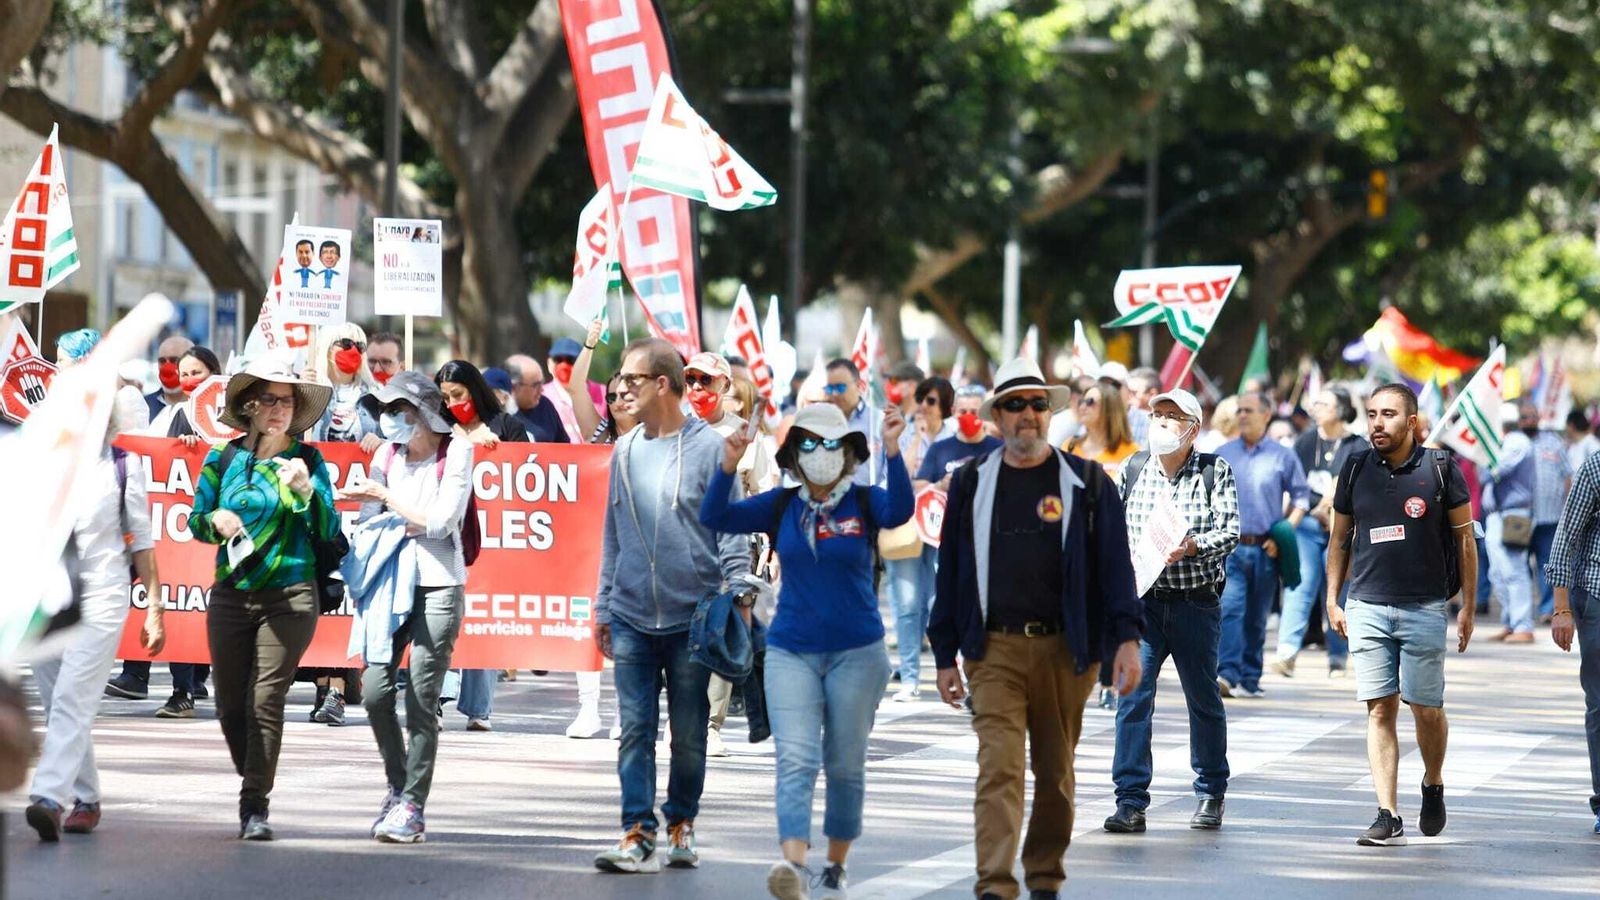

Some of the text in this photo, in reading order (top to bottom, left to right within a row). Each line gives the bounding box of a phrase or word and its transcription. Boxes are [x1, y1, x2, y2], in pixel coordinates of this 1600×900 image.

[384, 253, 398, 268] NO
[25, 384, 46, 405] NO
[464, 616, 591, 640] servicios málaga
